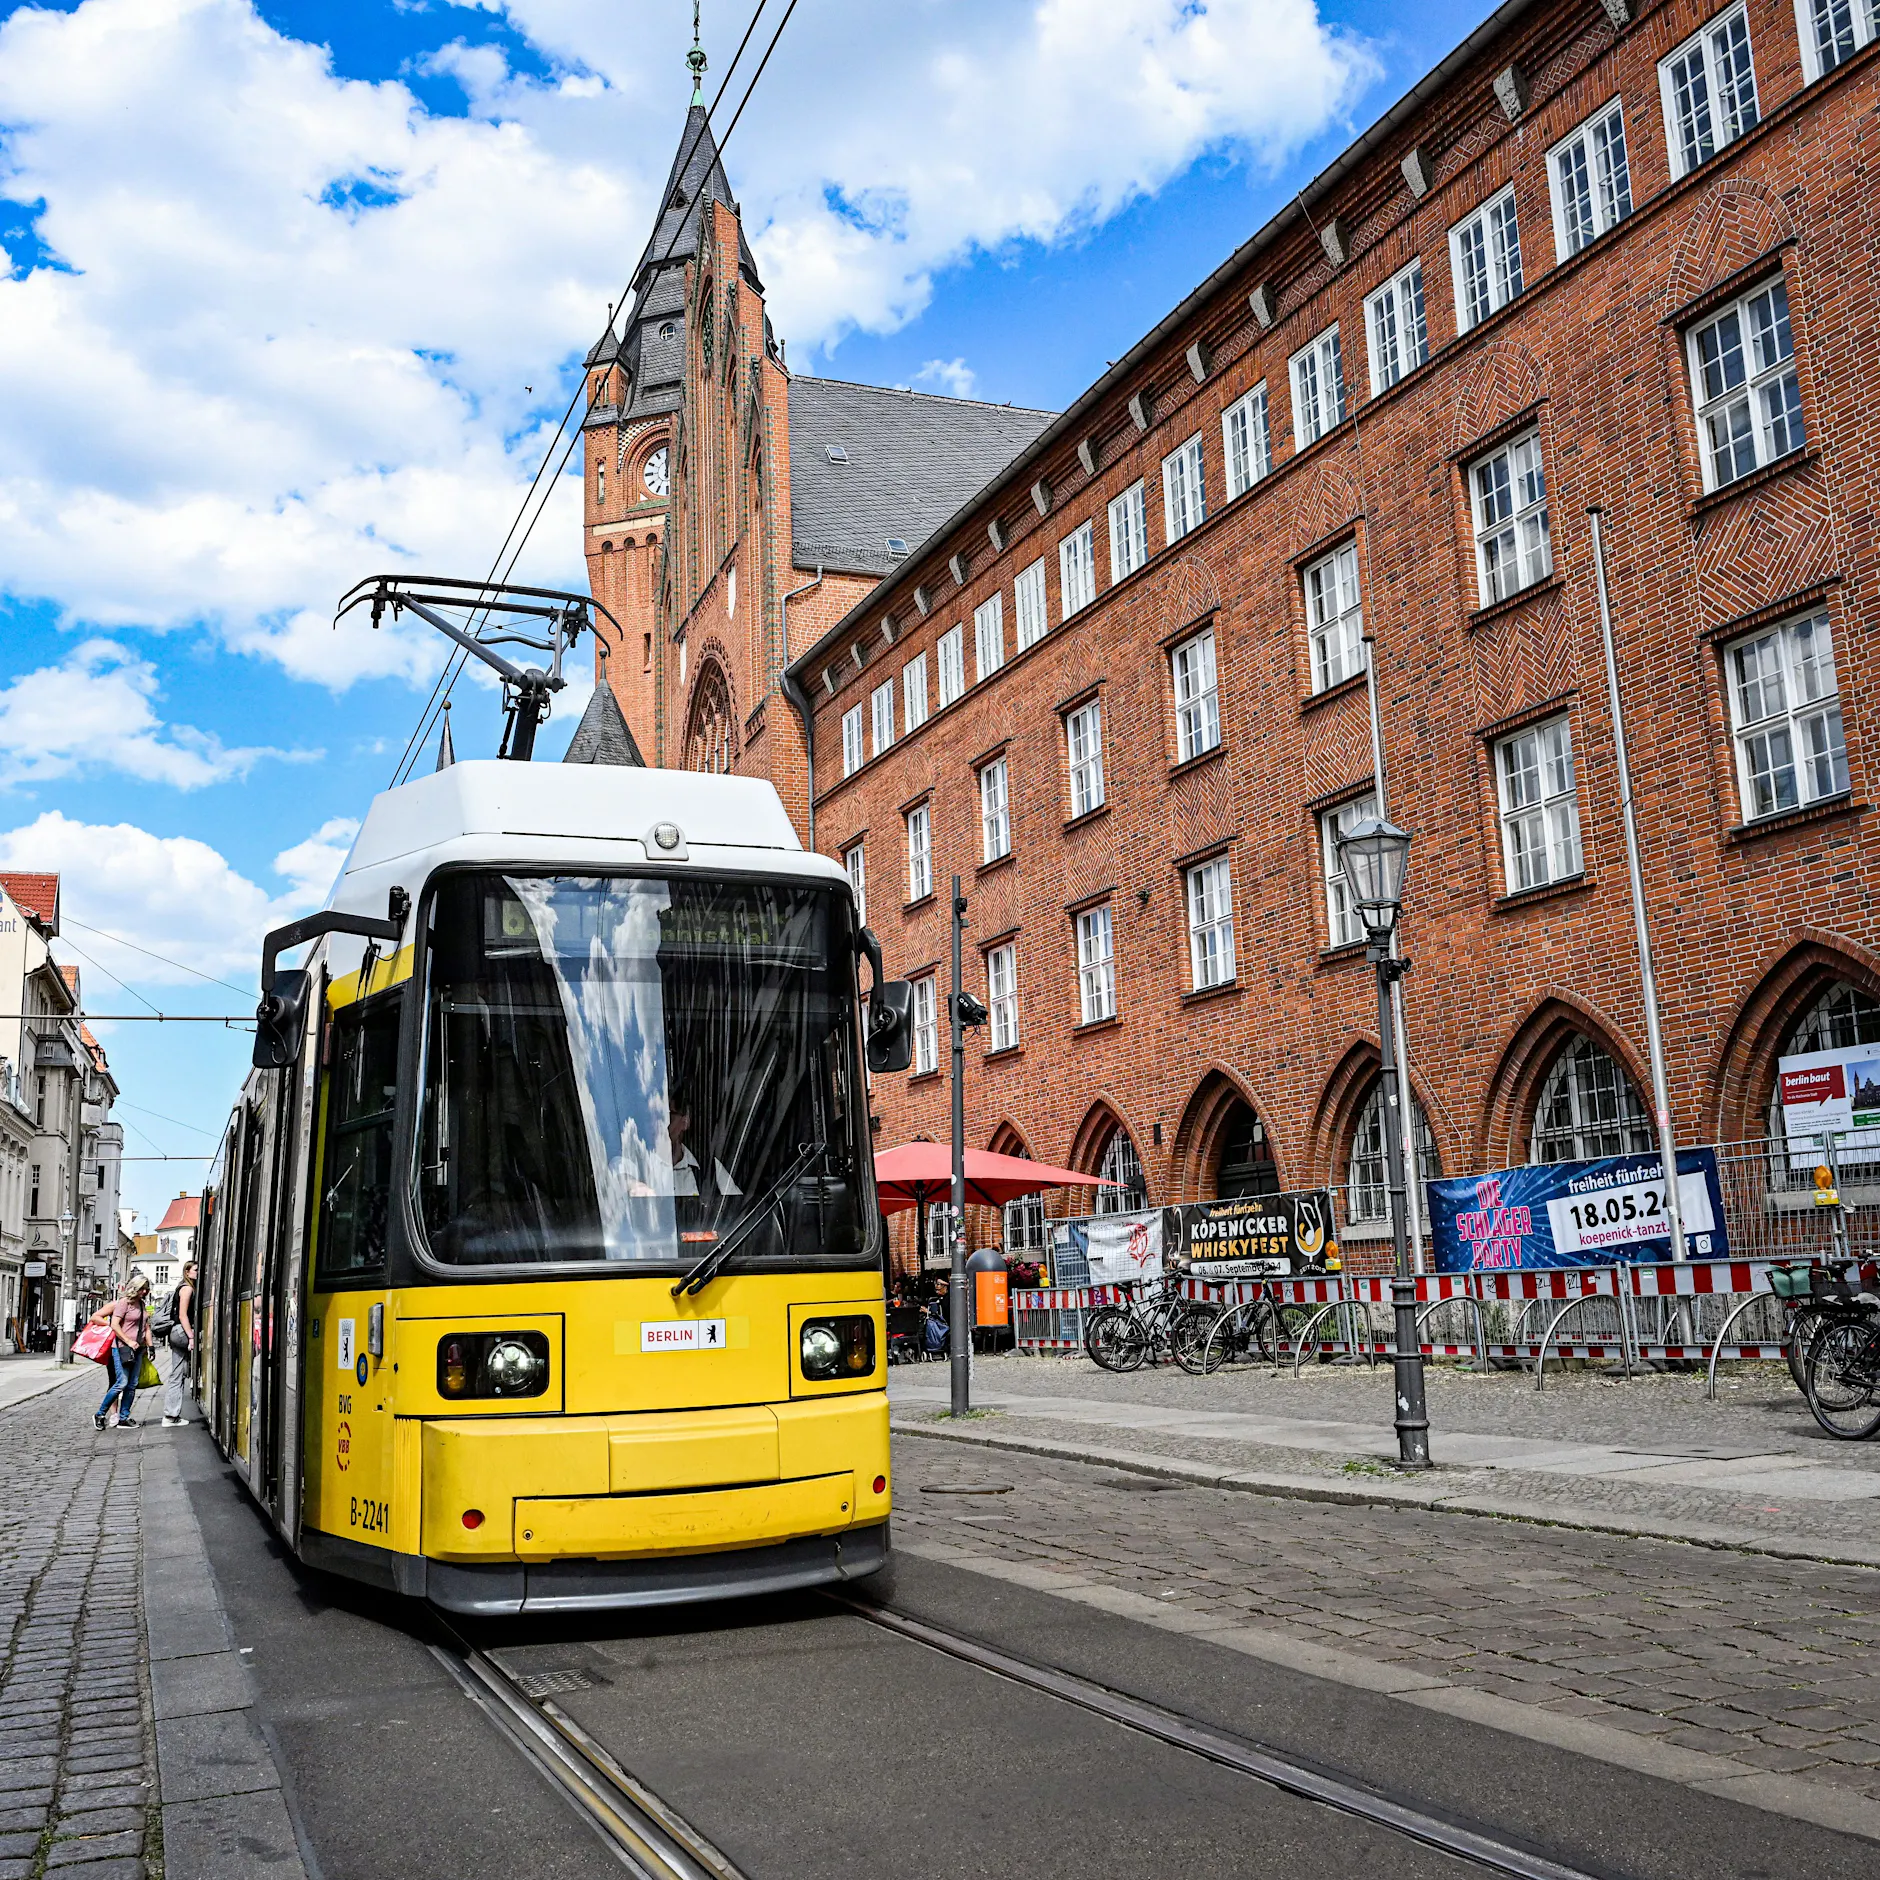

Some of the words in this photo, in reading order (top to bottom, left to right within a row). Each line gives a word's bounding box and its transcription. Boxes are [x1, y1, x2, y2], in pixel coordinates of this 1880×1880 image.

[1785, 1074, 1809, 1087] berlin
[1810, 1071, 1831, 1084] baut
[1568, 1173, 1614, 1194] freiheit
[1616, 1162, 1665, 1185] fünfzeh
[1476, 1180, 1503, 1210] DIE
[1209, 1205, 1232, 1217] freiheit
[1233, 1202, 1263, 1215] fünfzehn
[1191, 1216, 1288, 1240] KÖPENICKER
[1456, 1206, 1533, 1241] SCHLAGER
[1191, 1236, 1288, 1259] WHISKYFEST
[1472, 1237, 1521, 1269] PARTY
[1198, 1265, 1208, 1275] 06.
[1214, 1264, 1225, 1275] 07.
[647, 1329, 693, 1342] BERLIN
[339, 1394, 352, 1415] BVG
[338, 1438, 350, 1454] VBB
[350, 1496, 389, 1534] B-2241
